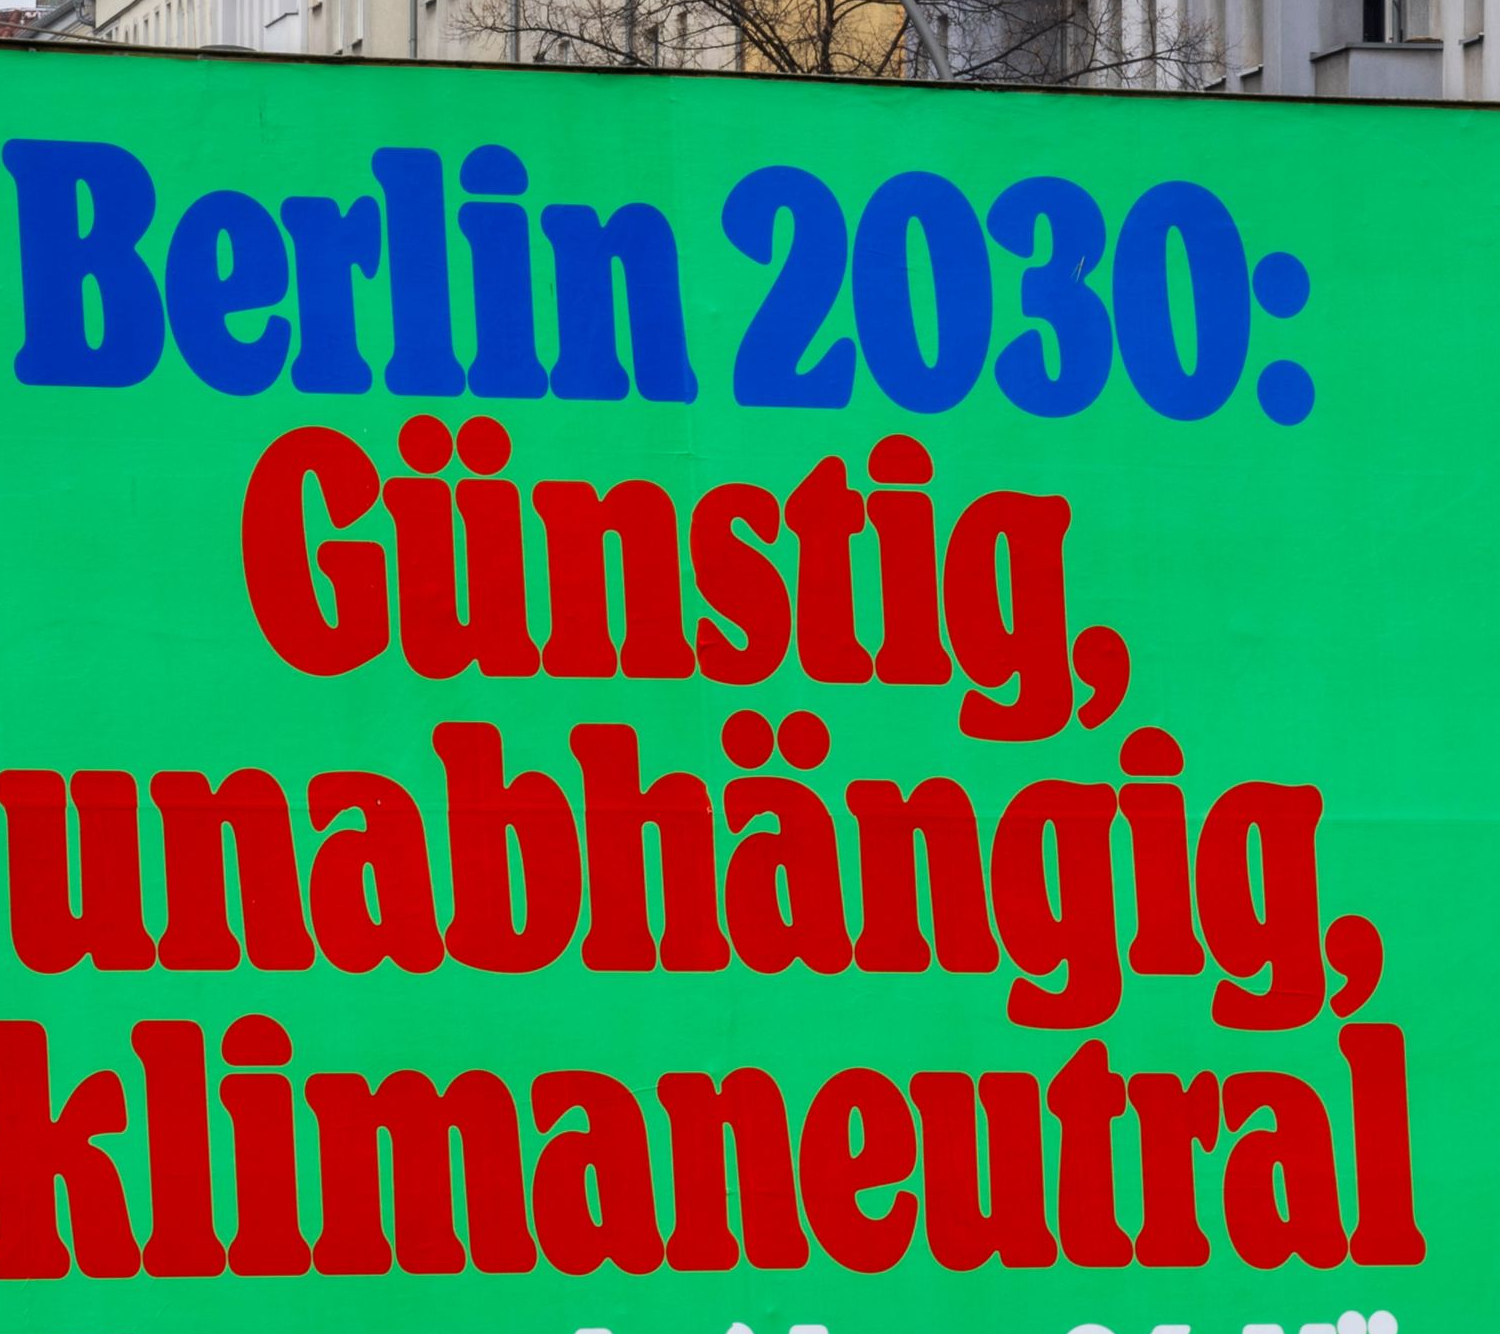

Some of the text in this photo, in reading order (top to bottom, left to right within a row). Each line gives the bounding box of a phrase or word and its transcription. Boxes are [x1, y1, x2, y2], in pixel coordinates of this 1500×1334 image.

[2, 138, 1315, 426] Berlin 2030:
[240, 414, 1131, 743] Günstig,
